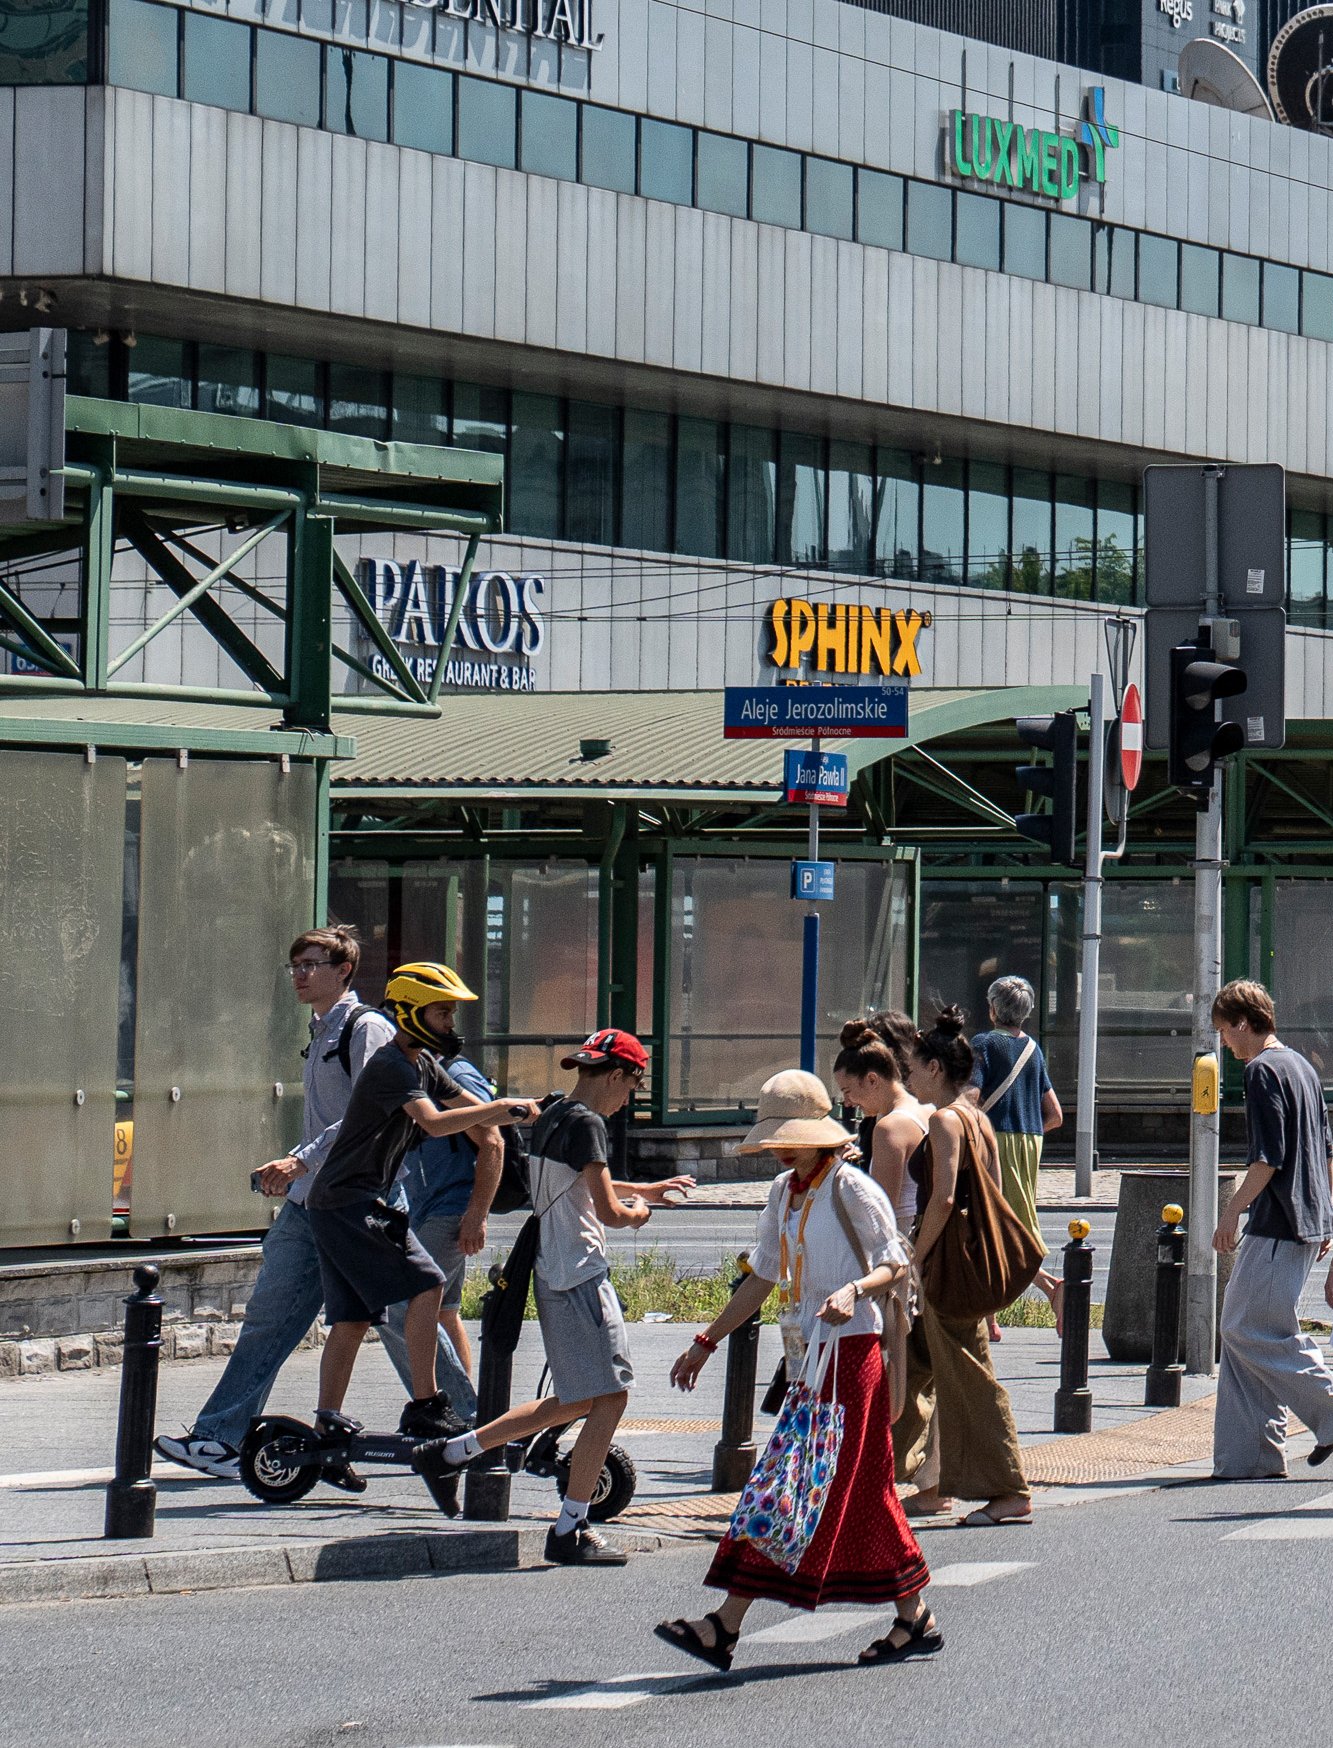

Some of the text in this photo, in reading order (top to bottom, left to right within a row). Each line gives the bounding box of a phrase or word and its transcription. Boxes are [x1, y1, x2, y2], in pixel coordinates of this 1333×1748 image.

[950, 109, 1079, 199] LUXMED
[772, 598, 923, 677] SPHINX
[372, 654, 536, 691] GRK REAURANT & BAR
[881, 687, 904, 696] 50-54
[740, 698, 888, 725] Aleje Jerozolimskie
[795, 763, 817, 784] Jana
[818, 765, 840, 786] Pawła
[803, 871, 813, 889] P
